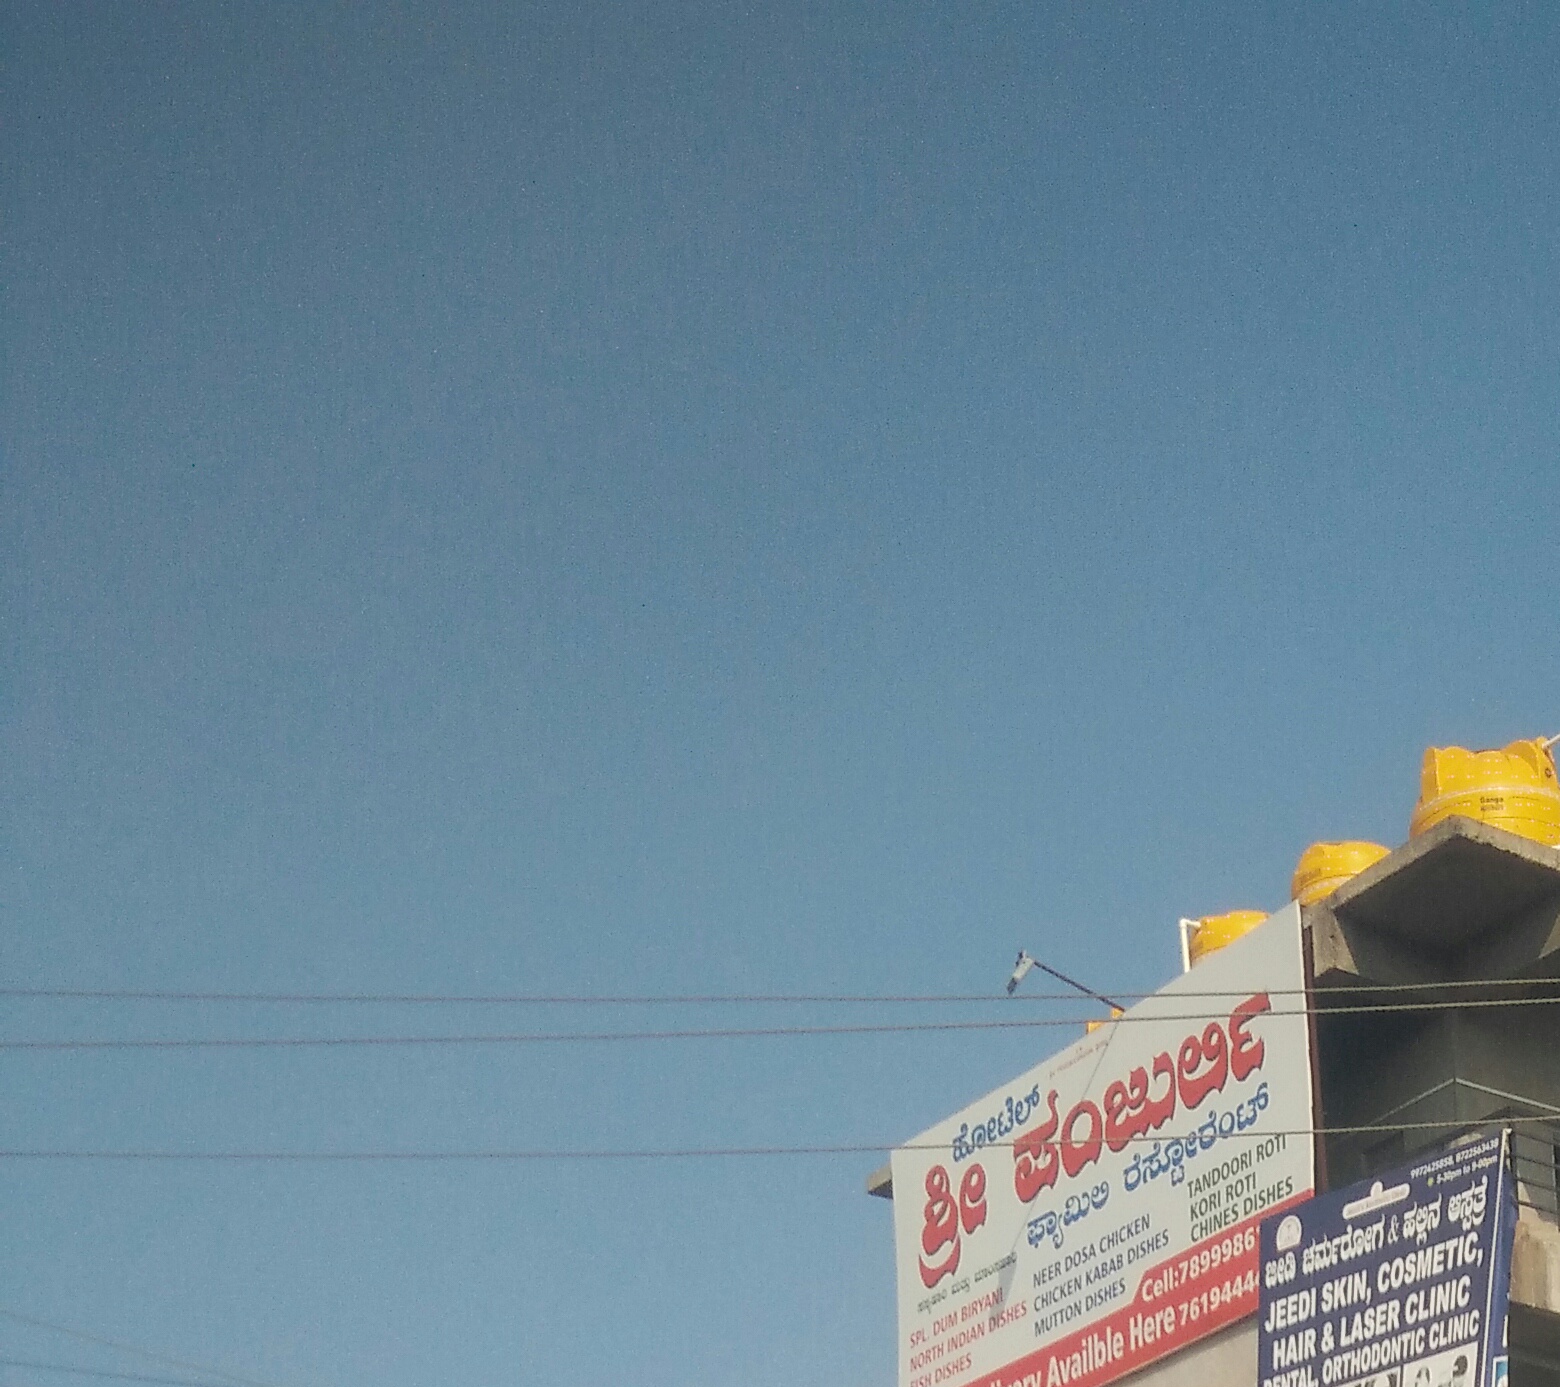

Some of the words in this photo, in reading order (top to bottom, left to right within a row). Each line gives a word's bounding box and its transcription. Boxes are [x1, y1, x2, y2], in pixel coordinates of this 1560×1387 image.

[952, 1084, 1040, 1162] ಹೋಟೆಲ್
[1187, 1152, 1252, 1198] TANDOORI
[1256, 1133, 1287, 1163] ROTI
[1190, 1193, 1222, 1222] KORI
[1226, 1172, 1257, 1200] ROTI
[918, 1163, 987, 1290] ಶ್ರೀ
[1027, 1181, 1110, 1250] ಫ್ಯಾಮಿಲಿ
[1190, 1204, 1239, 1243] CHINES
[1243, 1176, 1294, 1216] DISHES
[1387, 1214, 1400, 1245] &
[1033, 1263, 1062, 1288] NEER
[1064, 1244, 1097, 1272] DOSA
[1099, 1214, 1150, 1252] CHICKEN
[1034, 1276, 1082, 1312] CHICKEN
[1085, 1256, 1123, 1287] KABAB
[1127, 1229, 1169, 1264] DISHES
[1142, 1225, 1260, 1302] Cell:7899986
[1264, 1287, 1317, 1334] JEEDI
[1321, 1271, 1372, 1314] SKIN,
[1377, 1231, 1484, 1293] COSMETIC,
[910, 1343, 944, 1373] NORTH
[947, 1323, 985, 1356] INDIAN
[989, 1301, 1027, 1337] DISHES
[933, 1312, 958, 1336] DUM
[961, 1288, 1004, 1323] BIRYANI
[1034, 1300, 1082, 1338] MUTTON
[1085, 1277, 1126, 1311] DISHES
[1129, 1305, 1175, 1352] Here
[1273, 1327, 1317, 1371] HAIR
[1321, 1321, 1334, 1352] &
[1340, 1298, 1401, 1347] LASER
[1404, 1274, 1471, 1325] CLINIC
[935, 1353, 972, 1385] DISHES
[1322, 1326, 1426, 1385] ORTHODONTIC
[1428, 1309, 1480, 1350] CLINIC
